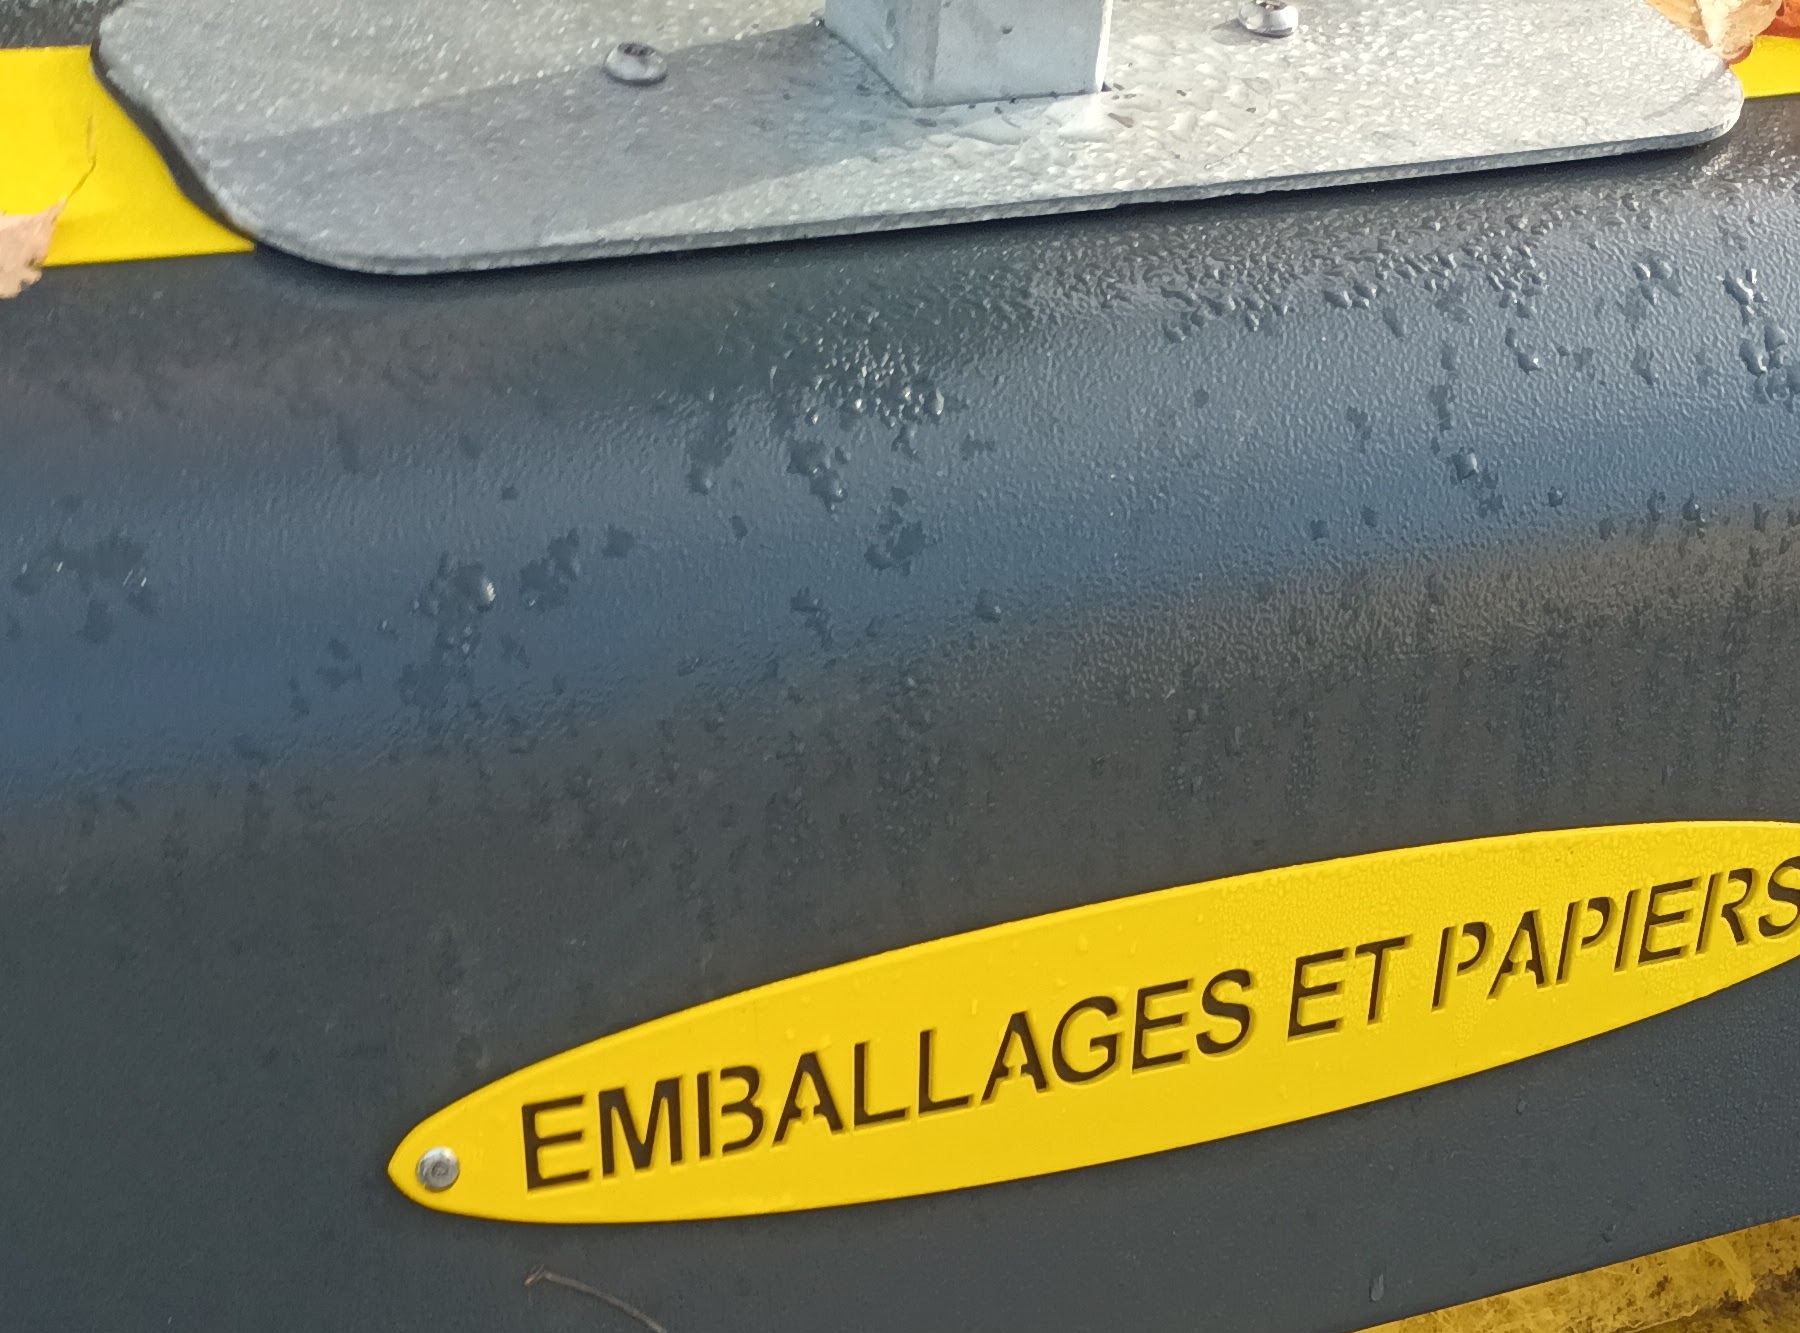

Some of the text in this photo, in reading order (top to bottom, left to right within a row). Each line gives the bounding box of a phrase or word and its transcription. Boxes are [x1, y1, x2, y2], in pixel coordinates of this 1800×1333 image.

[521, 855, 1800, 1193] EMBALLAGES ET PAPIERS
